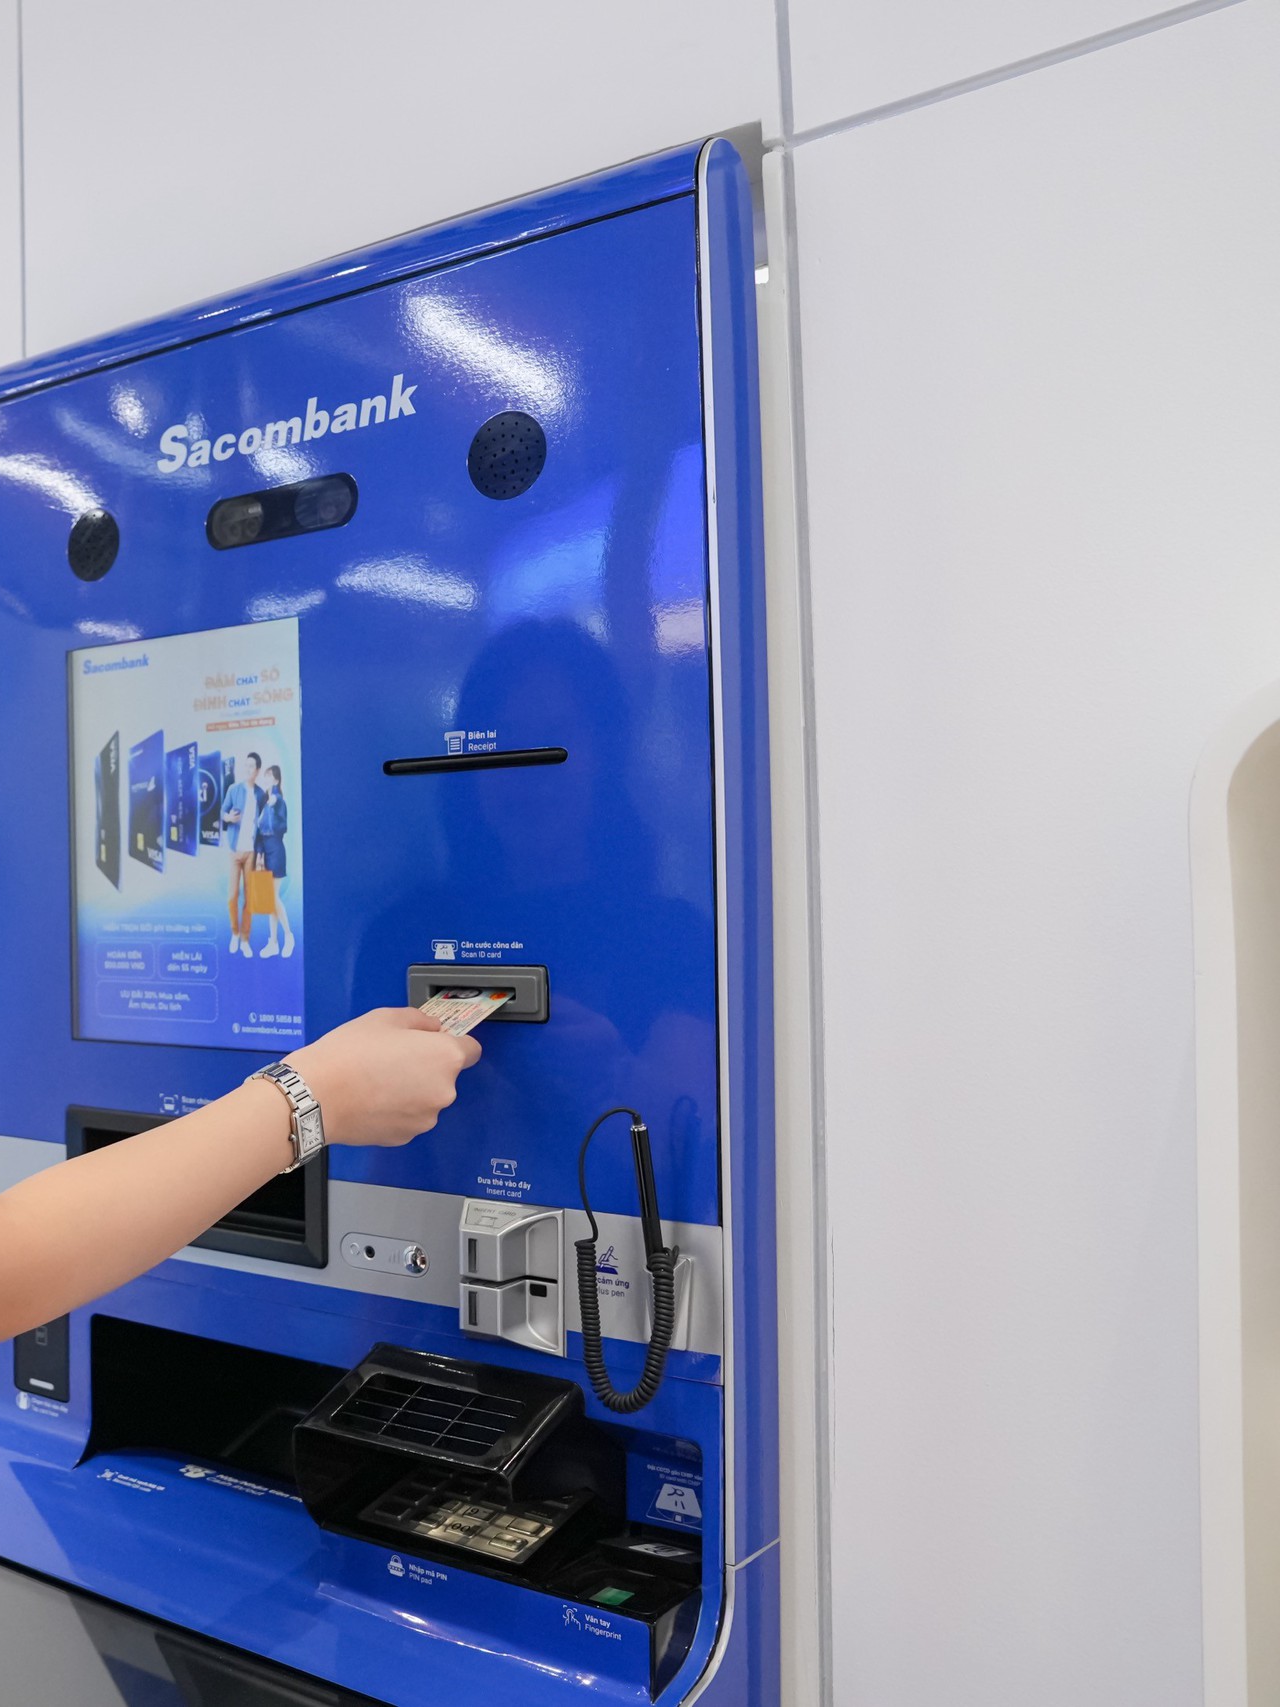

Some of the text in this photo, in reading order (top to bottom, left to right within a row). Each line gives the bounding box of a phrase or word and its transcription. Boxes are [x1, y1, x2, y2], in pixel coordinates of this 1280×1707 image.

[157, 373, 418, 473] Sacombank
[82, 654, 150, 675] Sacombank
[467, 729, 497, 740] Biên lai
[468, 742, 497, 752] Receipt
[201, 830, 220, 840] VISA
[510, 941, 524, 949] dân
[241, 1026, 302, 1036] sacombank.com.vn
[477, 1176, 531, 1191] Đưa thẻ vào đây
[486, 1187, 522, 1198] Insert card
[615, 1278, 630, 1289] ứng
[611, 1289, 625, 1297] pen
[408, 1563, 448, 1581] Nhập mã PIN
[409, 1572, 433, 1585] PIN pad
[584, 1613, 611, 1629] Vân tay
[584, 1623, 622, 1641] Fingerprint
